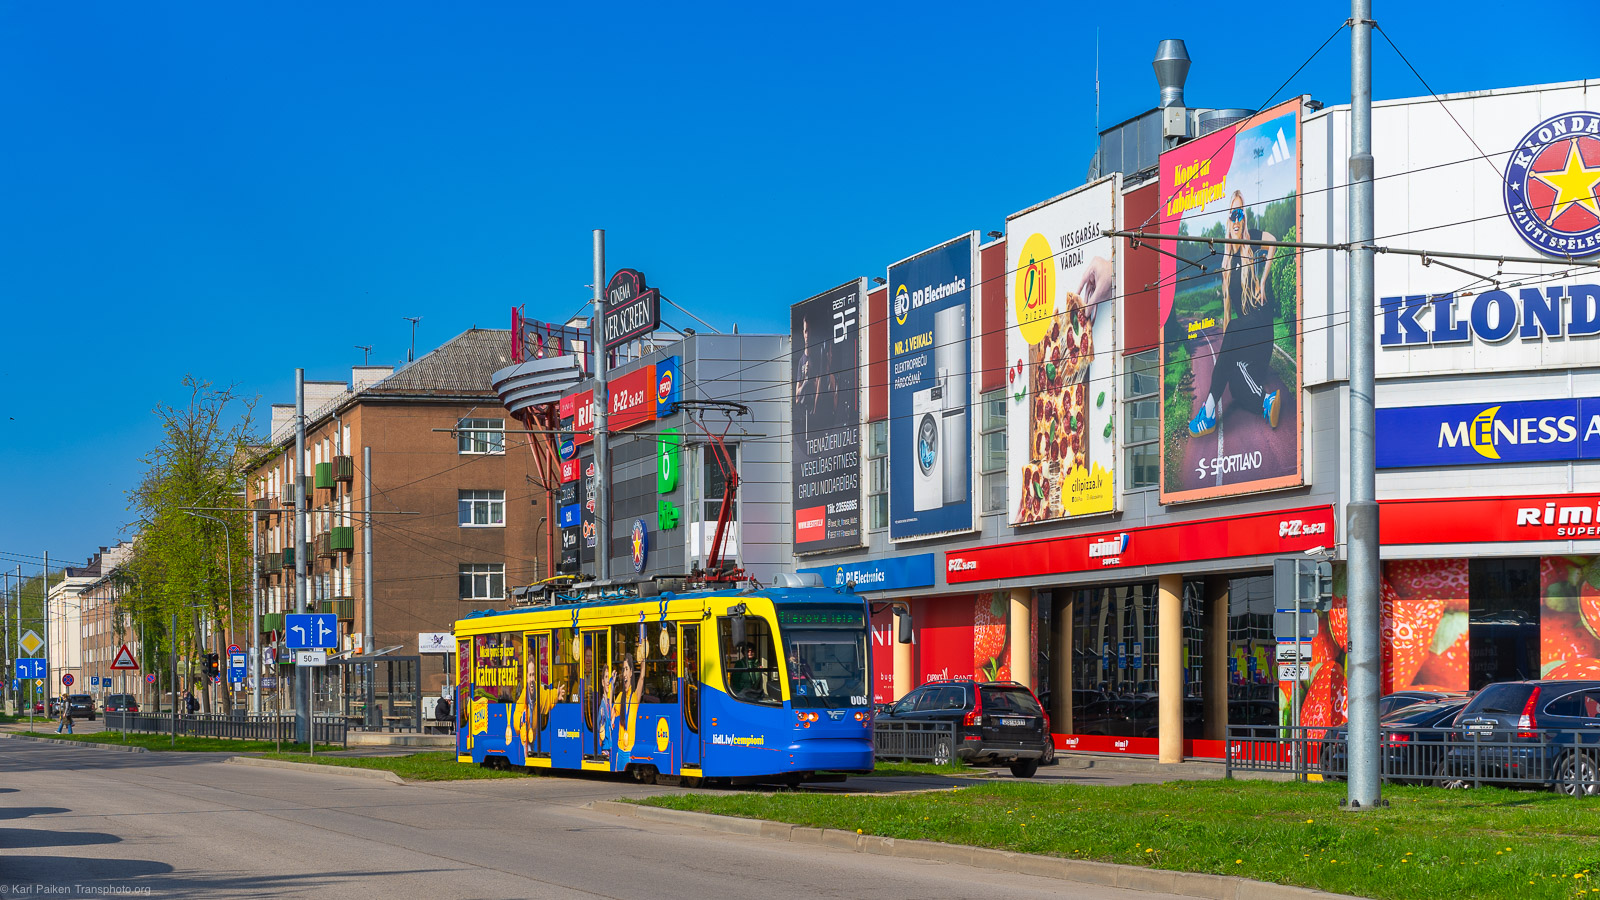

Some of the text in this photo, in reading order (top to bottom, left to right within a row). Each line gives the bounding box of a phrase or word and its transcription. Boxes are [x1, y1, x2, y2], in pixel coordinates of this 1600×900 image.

[1174, 160, 1199, 188] Kopā
[1060, 221, 1100, 249] VISS GARŠAS
[1513, 203, 1548, 243] IZJŪTI
[1060, 249, 1084, 271] VĀRDĀ!
[610, 282, 631, 306] CINEMA
[832, 297, 846, 310] BEST
[912, 275, 966, 309] RD Electronics
[619, 297, 650, 335] SCREEN
[833, 306, 856, 344] BF
[1026, 309, 1048, 321] PIZZA
[894, 331, 933, 355] NR. 1 VEIKALS
[895, 354, 928, 374] ELEKTROPREČU
[613, 390, 628, 413] 8-22
[660, 382, 671, 399] PEPCO
[806, 428, 858, 455] TRENAŽIERU ZĀLE
[1437, 414, 1577, 448] MĒNESS
[800, 450, 858, 477] VESELĪBAS FITNESS
[1210, 451, 1262, 475] SPORTLAND
[798, 473, 858, 499] GRUPU NODARBĪBAS
[1072, 475, 1103, 495] cilipizza.lv
[1279, 520, 1302, 537] 8-22
[854, 568, 885, 584] Electronics
[476, 659, 518, 687] katru reizi!
[953, 674, 973, 682] GANT
[850, 694, 868, 706] 006
[712, 734, 764, 747] lidl.lv/cempioni
